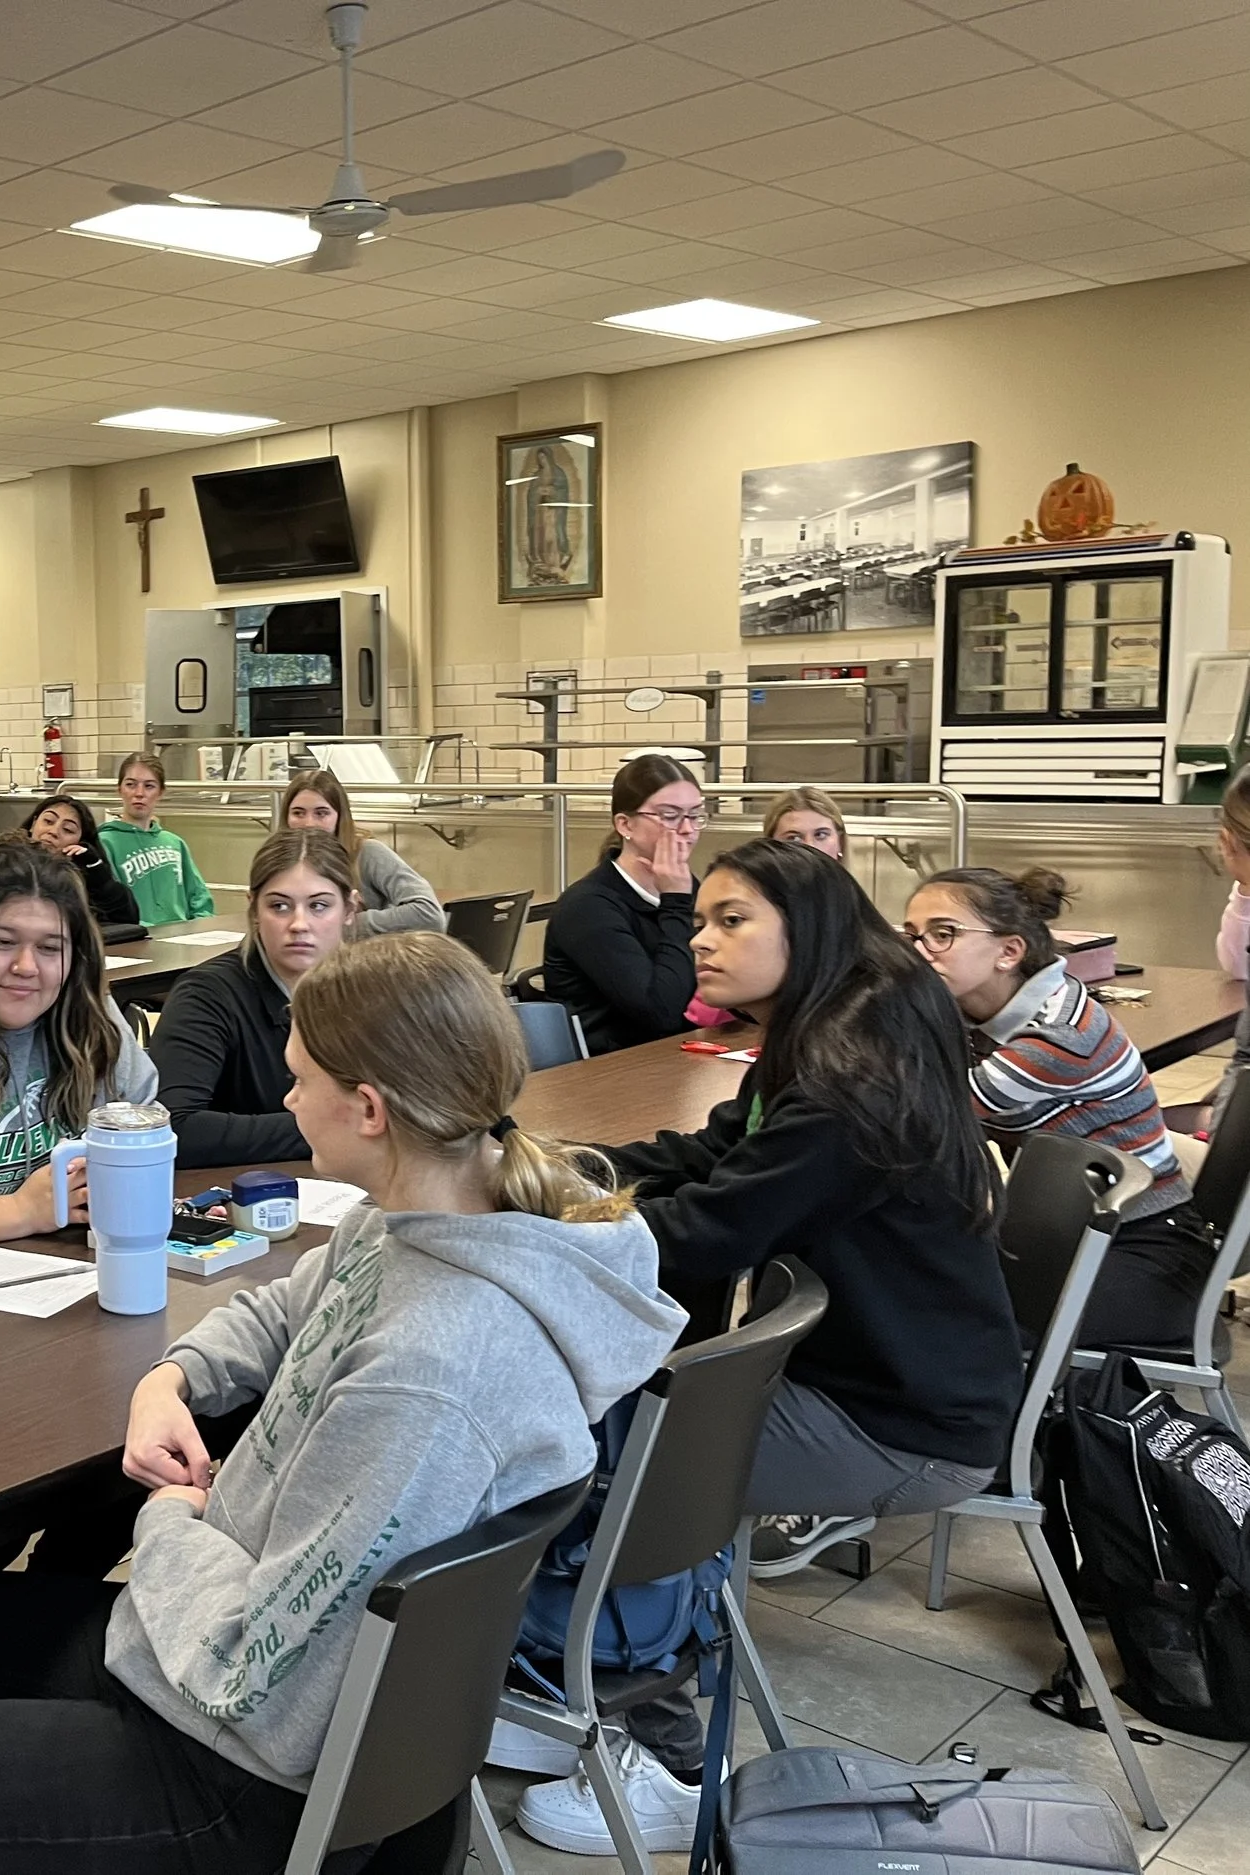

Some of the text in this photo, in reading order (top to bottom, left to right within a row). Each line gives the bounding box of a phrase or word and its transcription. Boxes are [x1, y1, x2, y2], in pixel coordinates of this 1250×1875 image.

[121, 849, 183, 887] PIONEE
[287, 1550, 344, 1615] State
[877, 1862, 920, 1871] FLEXVENT
